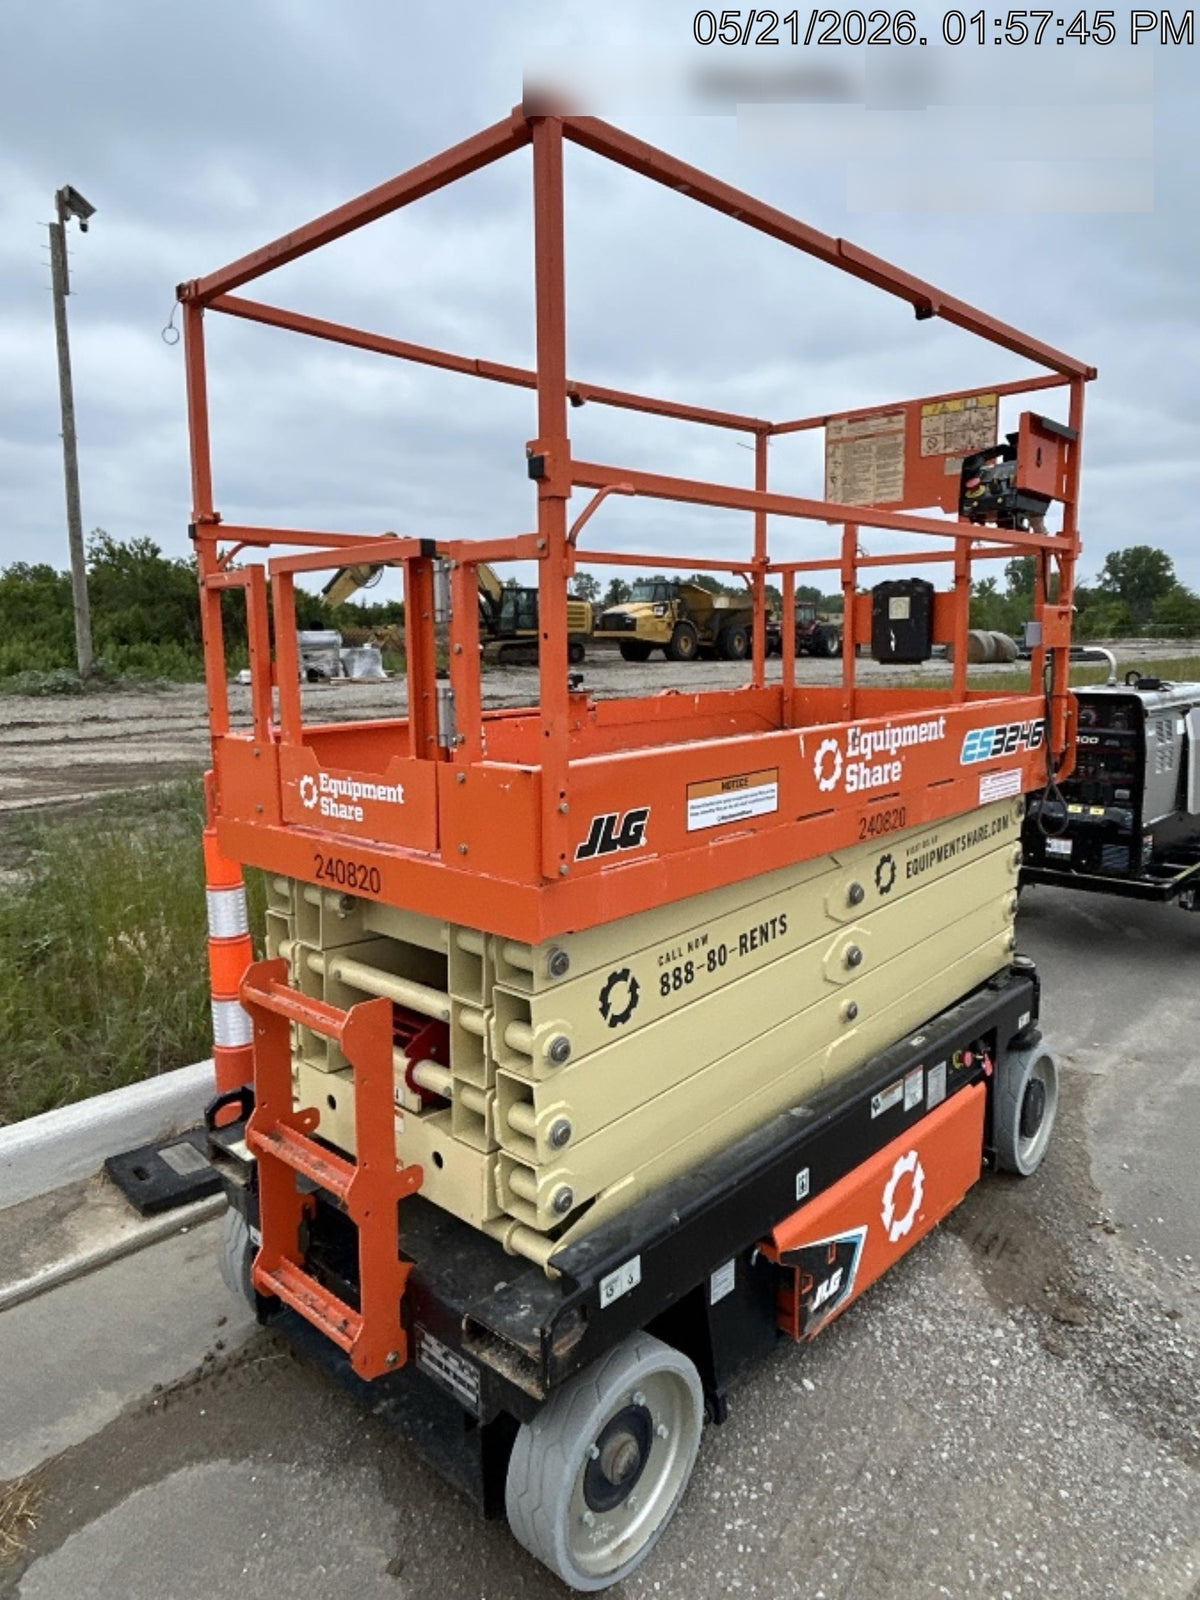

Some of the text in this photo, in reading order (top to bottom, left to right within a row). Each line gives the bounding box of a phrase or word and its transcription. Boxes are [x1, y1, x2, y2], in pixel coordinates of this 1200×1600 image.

[846, 716, 946, 761] Equipment
[960, 718, 1045, 765] ES3246
[319, 773, 405, 804] Equipment
[721, 777, 749, 792] NOTICE
[845, 760, 902, 793] Share
[320, 796, 363, 822] Share
[859, 806, 906, 840] 240820
[574, 806, 651, 862] JLG
[906, 814, 1009, 879] EQUIPMENTSHARE.COM
[314, 854, 381, 894] 240820
[658, 933, 708, 967] CALL NOW
[660, 913, 787, 996] 888-80-RENTS
[811, 1267, 843, 1312] JLG
